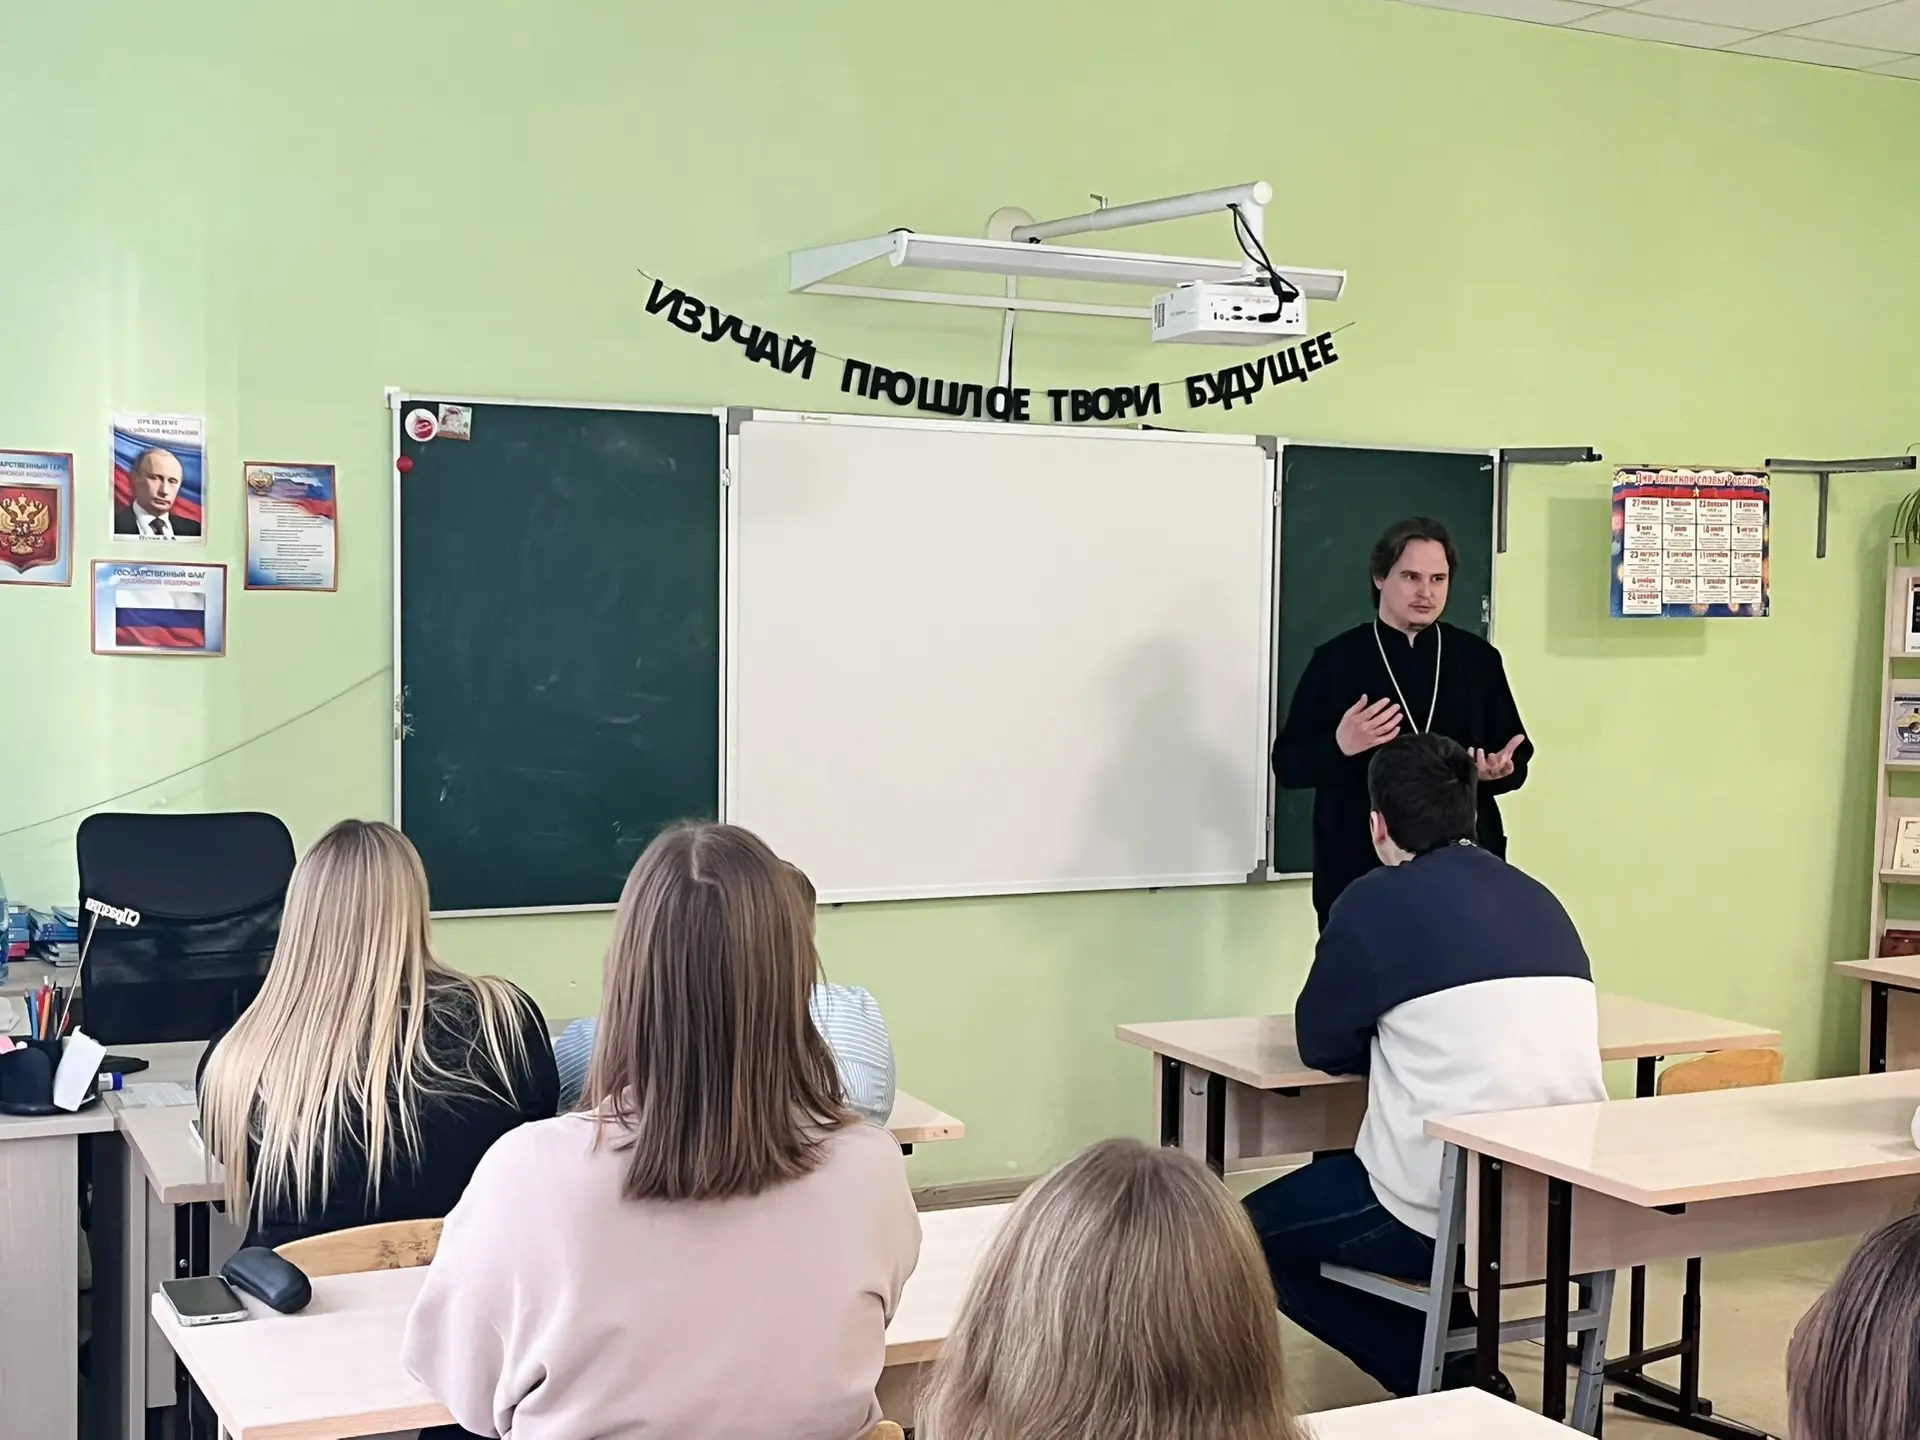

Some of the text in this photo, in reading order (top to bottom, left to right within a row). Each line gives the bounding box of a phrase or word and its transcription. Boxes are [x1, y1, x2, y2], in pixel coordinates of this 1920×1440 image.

[645, 278, 1339, 423] ИЗУЧАЙ ПРОШЛОЕ ТВОРИ БУДУЩЕЕ
[1635, 471, 1759, 486] Дни воинской славы России
[1632, 499, 1640, 507] 27
[113, 568, 206, 579] ГОСУДАРСТВЕННЫЙ ФЛАГ
[1628, 592, 1636, 601] 24
